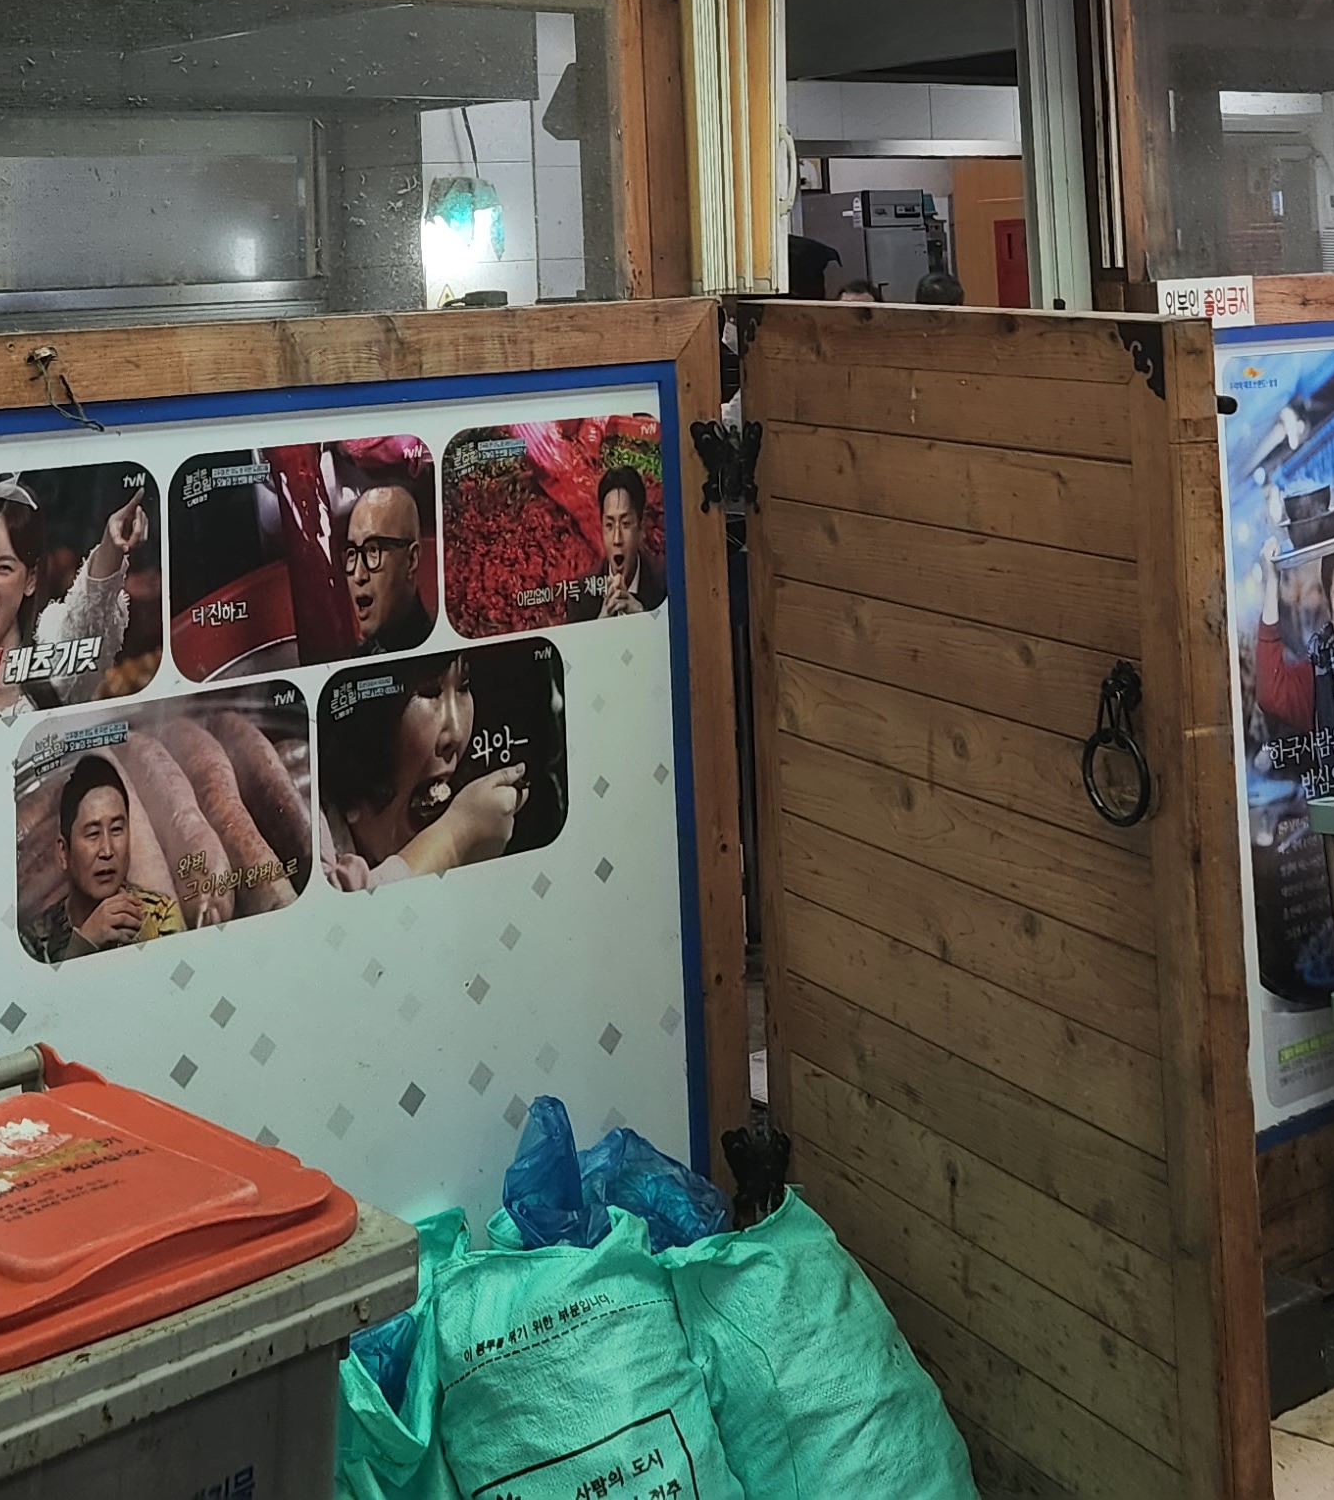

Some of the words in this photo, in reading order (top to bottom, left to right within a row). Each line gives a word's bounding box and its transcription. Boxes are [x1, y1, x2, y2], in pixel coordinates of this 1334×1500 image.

[1165, 288, 1200, 317] 외부인
[1203, 285, 1250, 317] 출입금지
[640, 423, 658, 436] tvN
[403, 443, 424, 461] tvN
[122, 472, 147, 489] tvN
[517, 587, 554, 606] 아낌없이
[555, 579, 581, 601] 가득
[191, 607, 208, 625] 더
[209, 600, 249, 626] 진하고
[533, 646, 553, 663] tvN
[273, 688, 296, 707] tvN
[463, 1346, 473, 1363] 이
[632, 1448, 665, 1477] 도시
